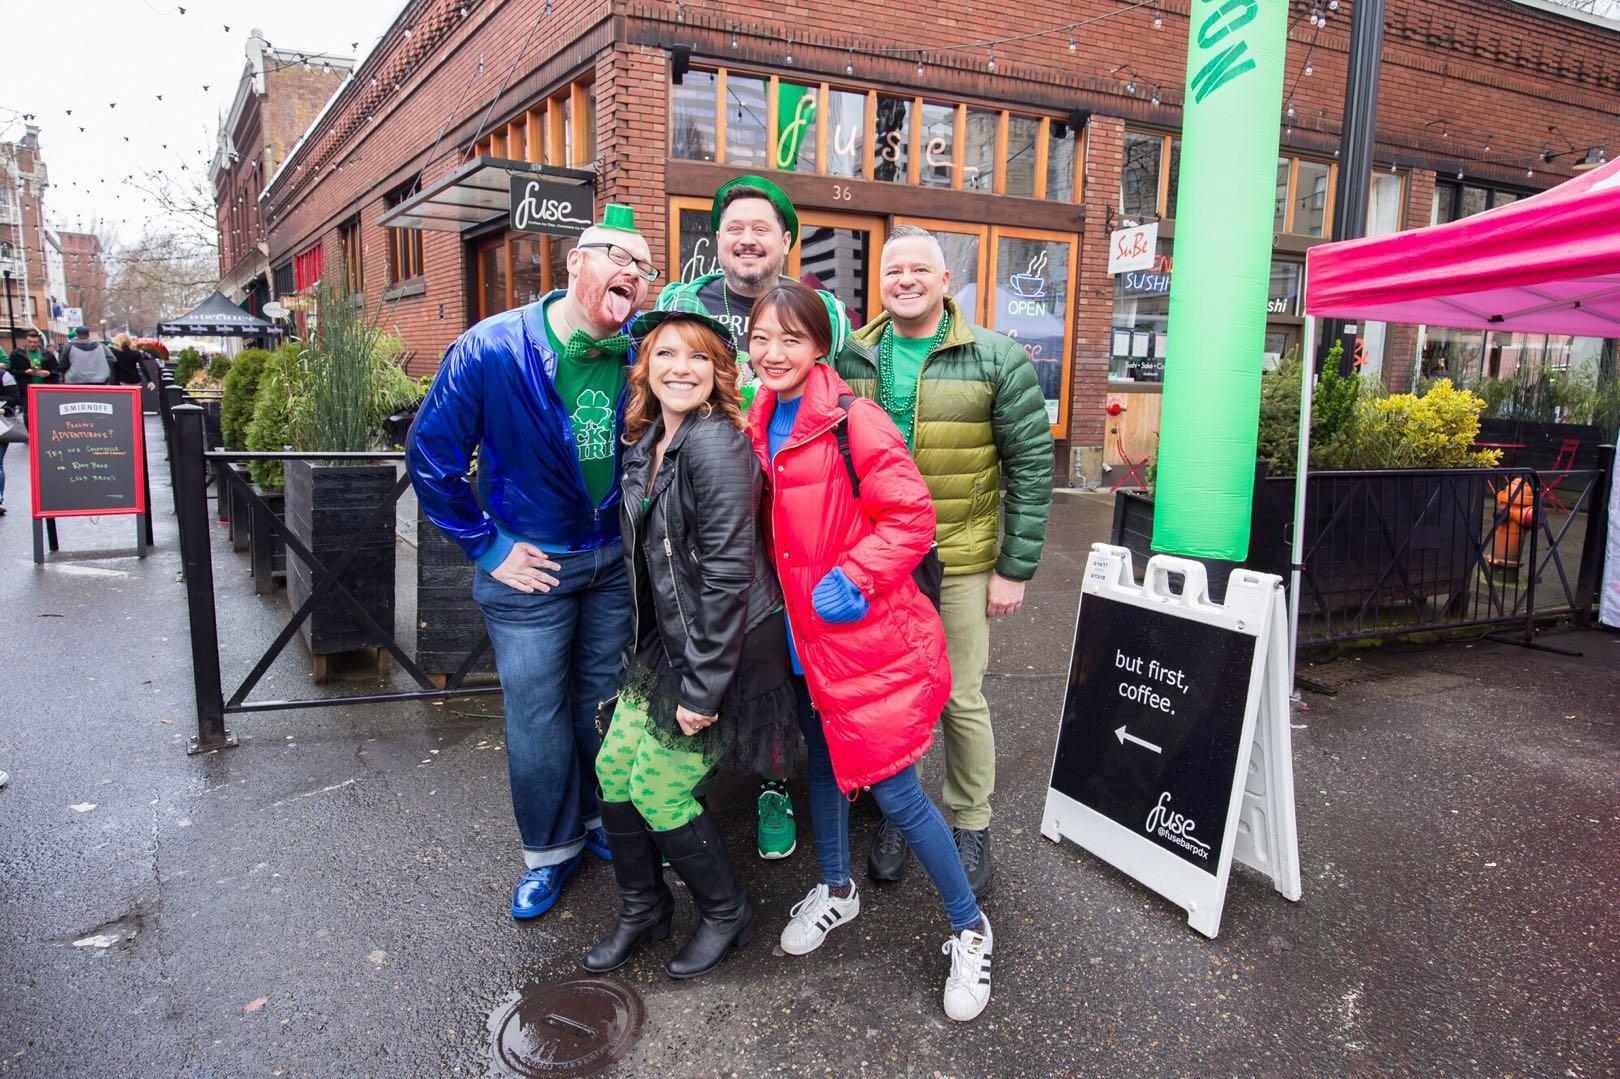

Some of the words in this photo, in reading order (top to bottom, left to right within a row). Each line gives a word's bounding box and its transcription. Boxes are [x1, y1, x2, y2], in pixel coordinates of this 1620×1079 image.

[776, 94, 978, 171] fuse
[515, 180, 592, 230] fuse
[832, 185, 852, 201] 36
[681, 237, 725, 284] fu
[1116, 231, 1148, 260] SuBe
[1125, 272, 1170, 292] SUSHI
[1008, 300, 1046, 316] OPEN
[1266, 298, 1288, 313] shi
[64, 404, 108, 413] SMIRNOFF
[577, 442, 615, 462] IRI
[1115, 649, 1144, 674] but
[1148, 660, 1189, 694] first,
[1118, 682, 1175, 715] coffee.
[1145, 791, 1211, 850] fuse
[1157, 826, 1209, 860] @fusebarpdx
